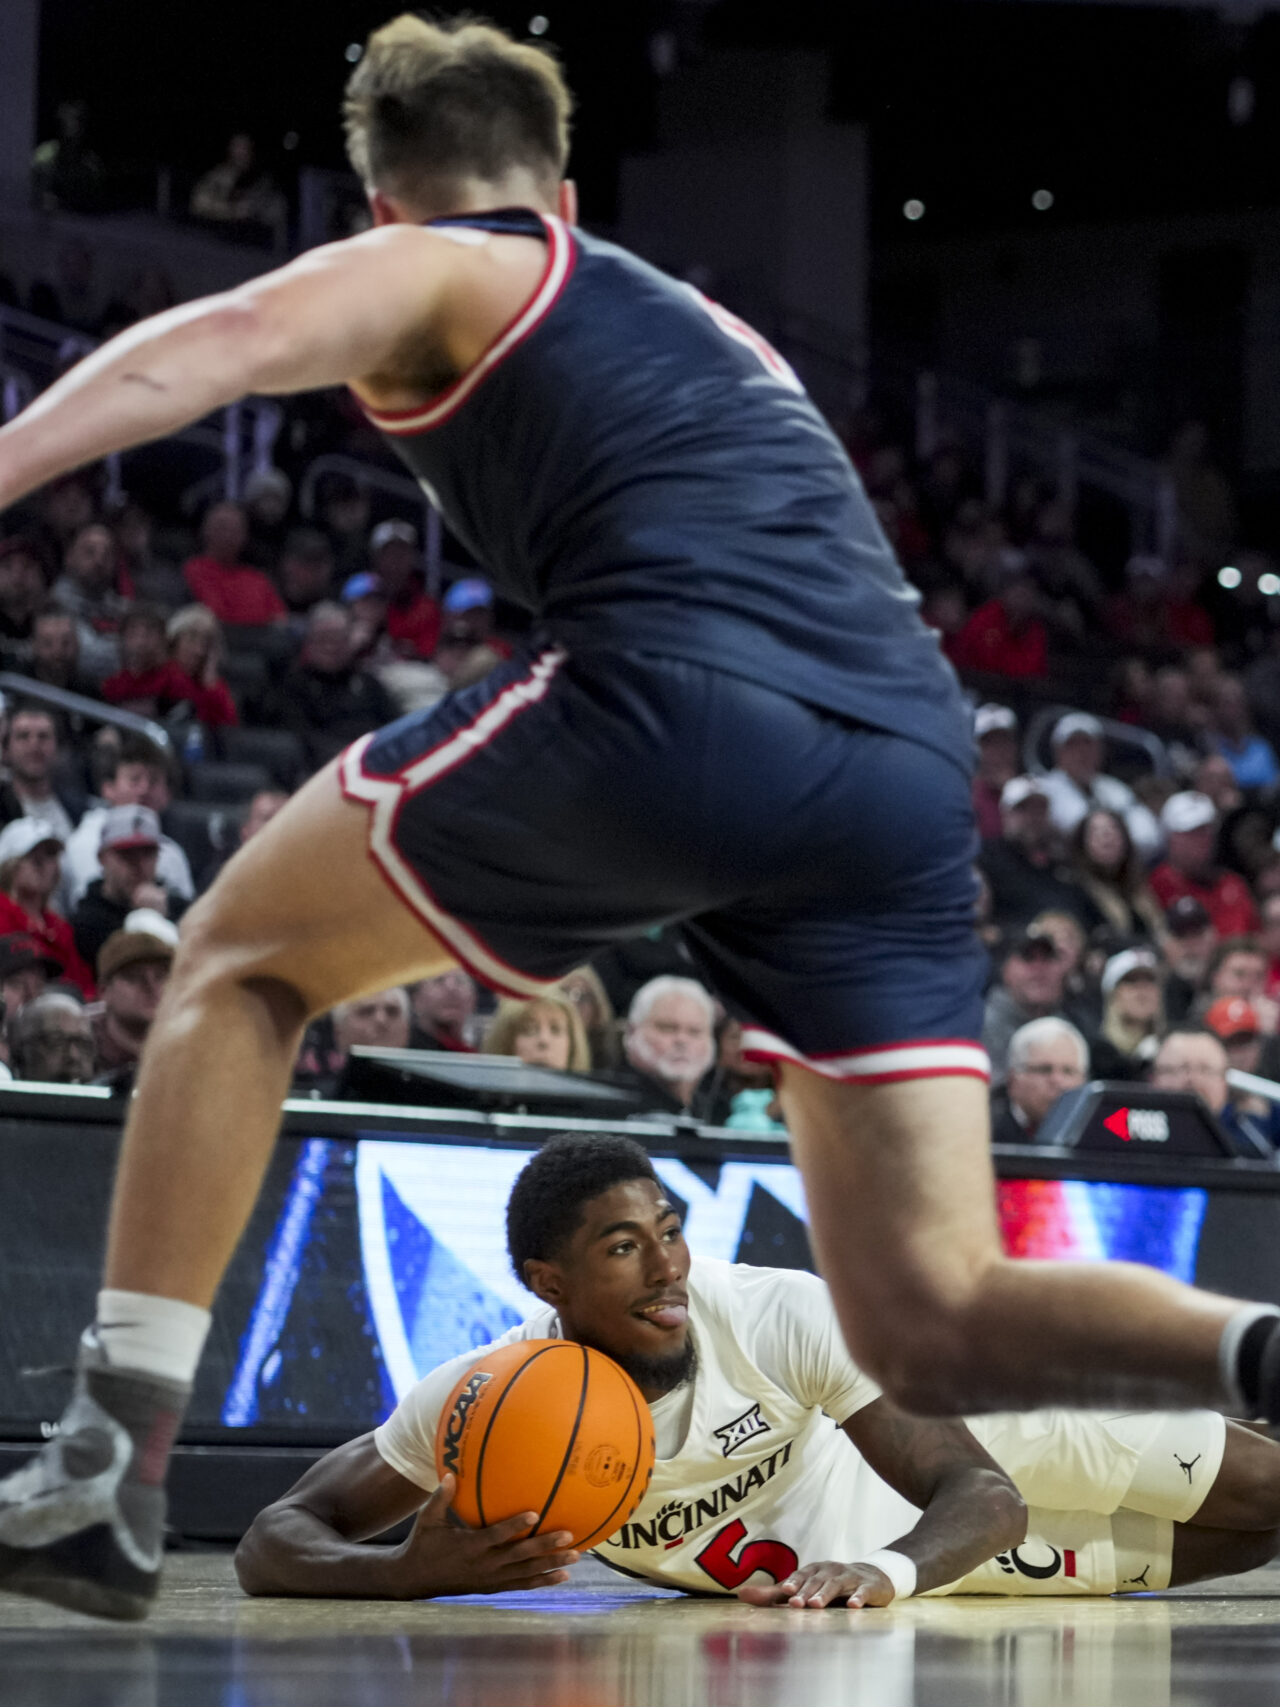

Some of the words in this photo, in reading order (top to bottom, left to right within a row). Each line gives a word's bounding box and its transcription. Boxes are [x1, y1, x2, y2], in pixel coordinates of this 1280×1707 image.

[443, 1371, 494, 1476] NCAA
[606, 1439, 794, 1550] INCINNATI
[694, 1518, 798, 1590] 5
